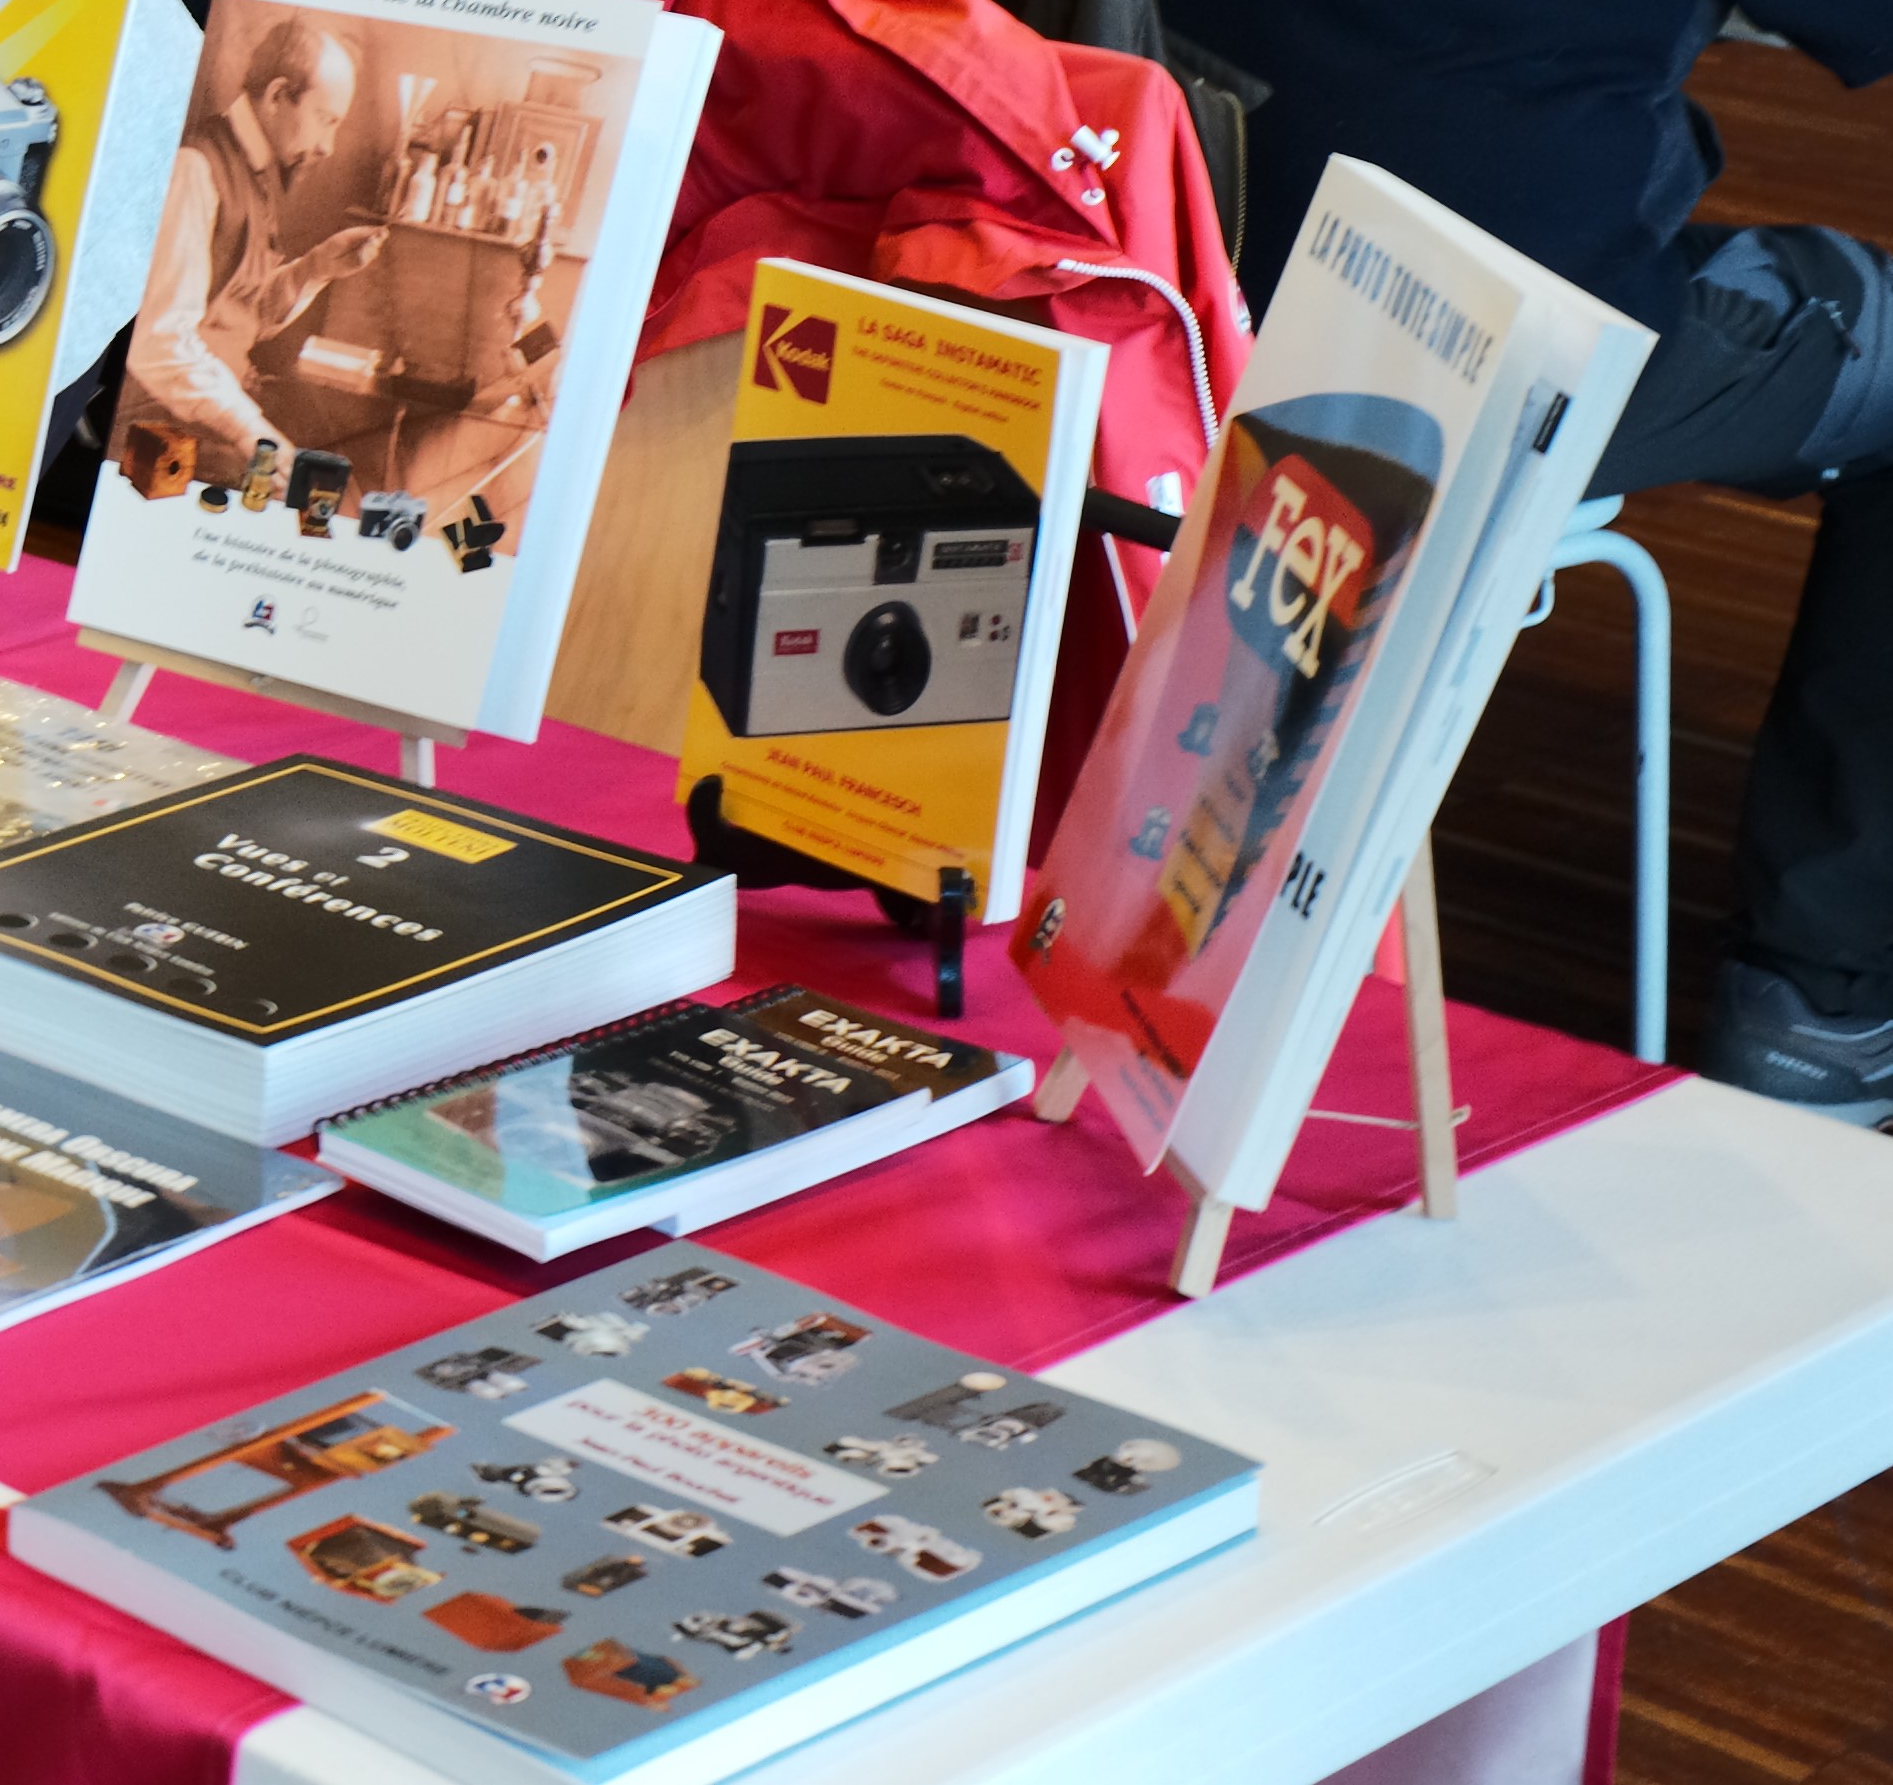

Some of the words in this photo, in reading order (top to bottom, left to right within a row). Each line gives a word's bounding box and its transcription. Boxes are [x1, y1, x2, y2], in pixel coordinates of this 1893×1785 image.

[538, 6, 599, 33] noire
[1309, 212, 1336, 271] LA
[1335, 224, 1393, 301] PHOTO
[1385, 262, 1440, 343] TOUTE
[1427, 294, 1495, 385] SIMPLE
[776, 339, 832, 371] Kodak
[200, 833, 325, 873] Vues
[301, 869, 356, 887] et
[347, 845, 421, 869] 2
[193, 851, 444, 943] Conférences
[674, 1027, 879, 1094] EXAKTA
[785, 1008, 971, 1070] EXAKTA
[811, 1034, 898, 1063] Guide
[703, 1053, 800, 1086] Guide
[6, 1150, 171, 1209] MAGIQUE
[46, 1133, 217, 1193] OBSCURA
[563, 1396, 632, 1424] pour
[619, 1417, 661, 1435] la
[641, 1427, 724, 1461] photo
[706, 1454, 842, 1511] argentique
[629, 1403, 701, 1433] 300
[683, 1425, 822, 1483] appareils
